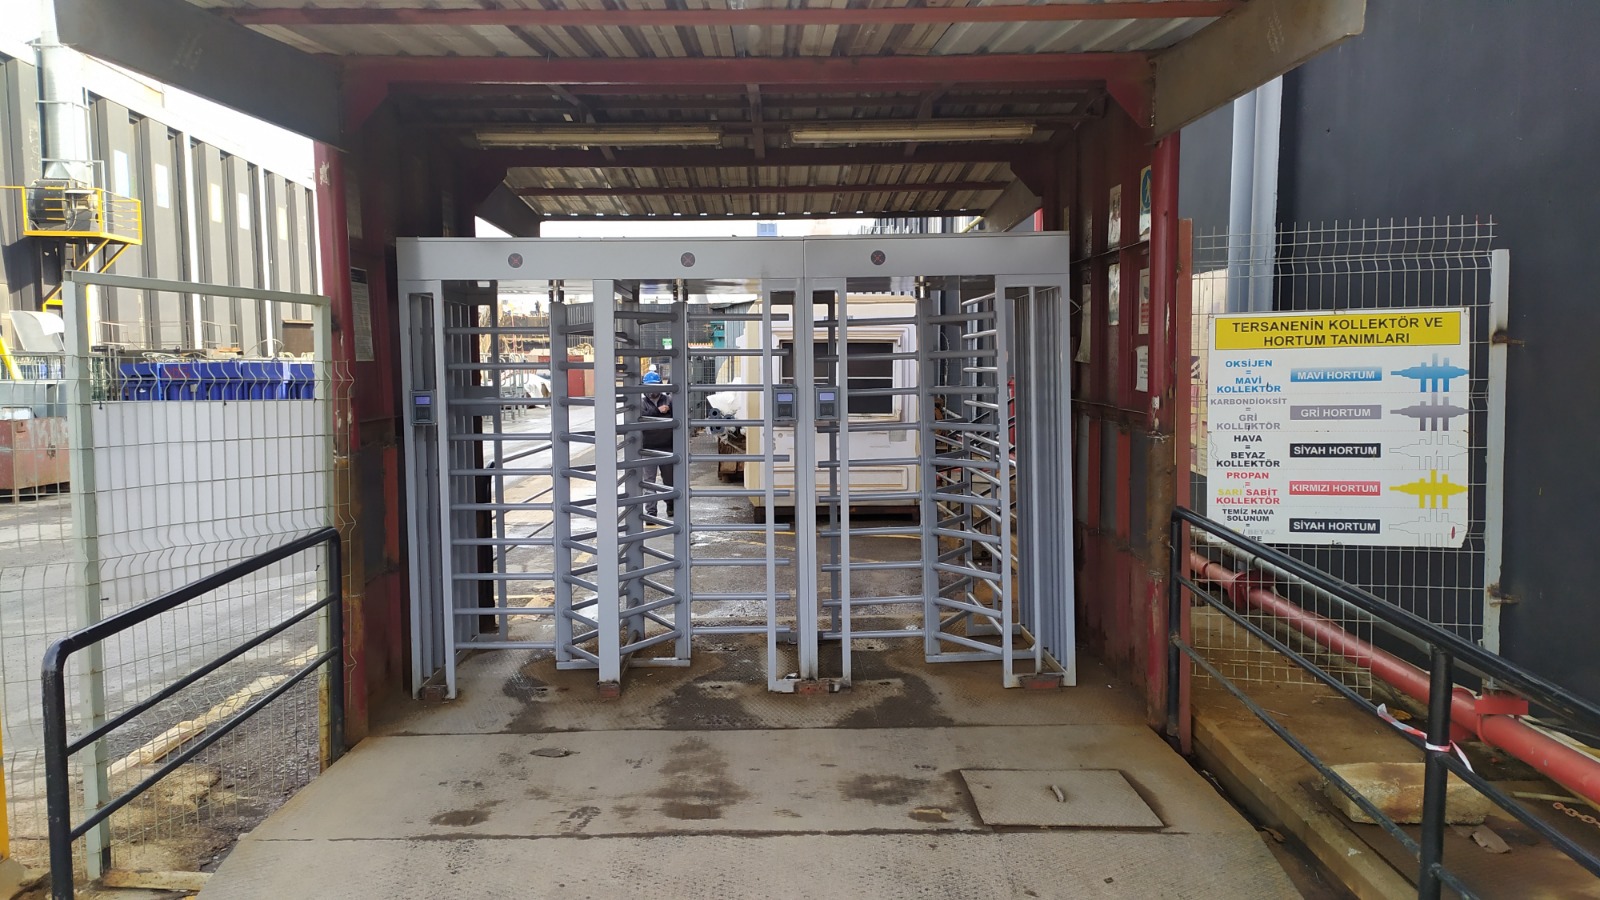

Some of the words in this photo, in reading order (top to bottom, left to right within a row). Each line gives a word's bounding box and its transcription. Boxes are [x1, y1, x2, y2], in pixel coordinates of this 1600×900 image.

[1232, 318, 1324, 333] TERSANENİN
[1329, 317, 1419, 330] KOLLEKTÖR
[1425, 317, 1443, 328] VE
[1264, 335, 1326, 347] HORTUM
[1330, 333, 1410, 345] TANIMLARI
[1225, 359, 1273, 367] OKSİJEN
[1297, 370, 1324, 380] MAVİ
[1326, 370, 1375, 380] HORTUM
[1235, 376, 1262, 384] MAVİ
[1216, 385, 1281, 393] KOLLEKTÖR
[1300, 407, 1321, 417] GRİ
[1323, 408, 1371, 417] HORTUM
[1239, 413, 1257, 422] GRİ
[1216, 422, 1281, 430] KOLLEKTÖR
[1294, 445, 1326, 455] SİYAH
[1328, 445, 1377, 455] HORTUM
[1216, 459, 1280, 467] KOLLEKTÖR
[1246, 488, 1278, 496] SABİT
[1291, 484, 1330, 493] KIRMIZI
[1332, 483, 1378, 493] HORTUM
[1216, 496, 1280, 504] KOLLEKTÖR
[1293, 520, 1326, 530] SİYAH
[1328, 521, 1376, 531] HORTUM
